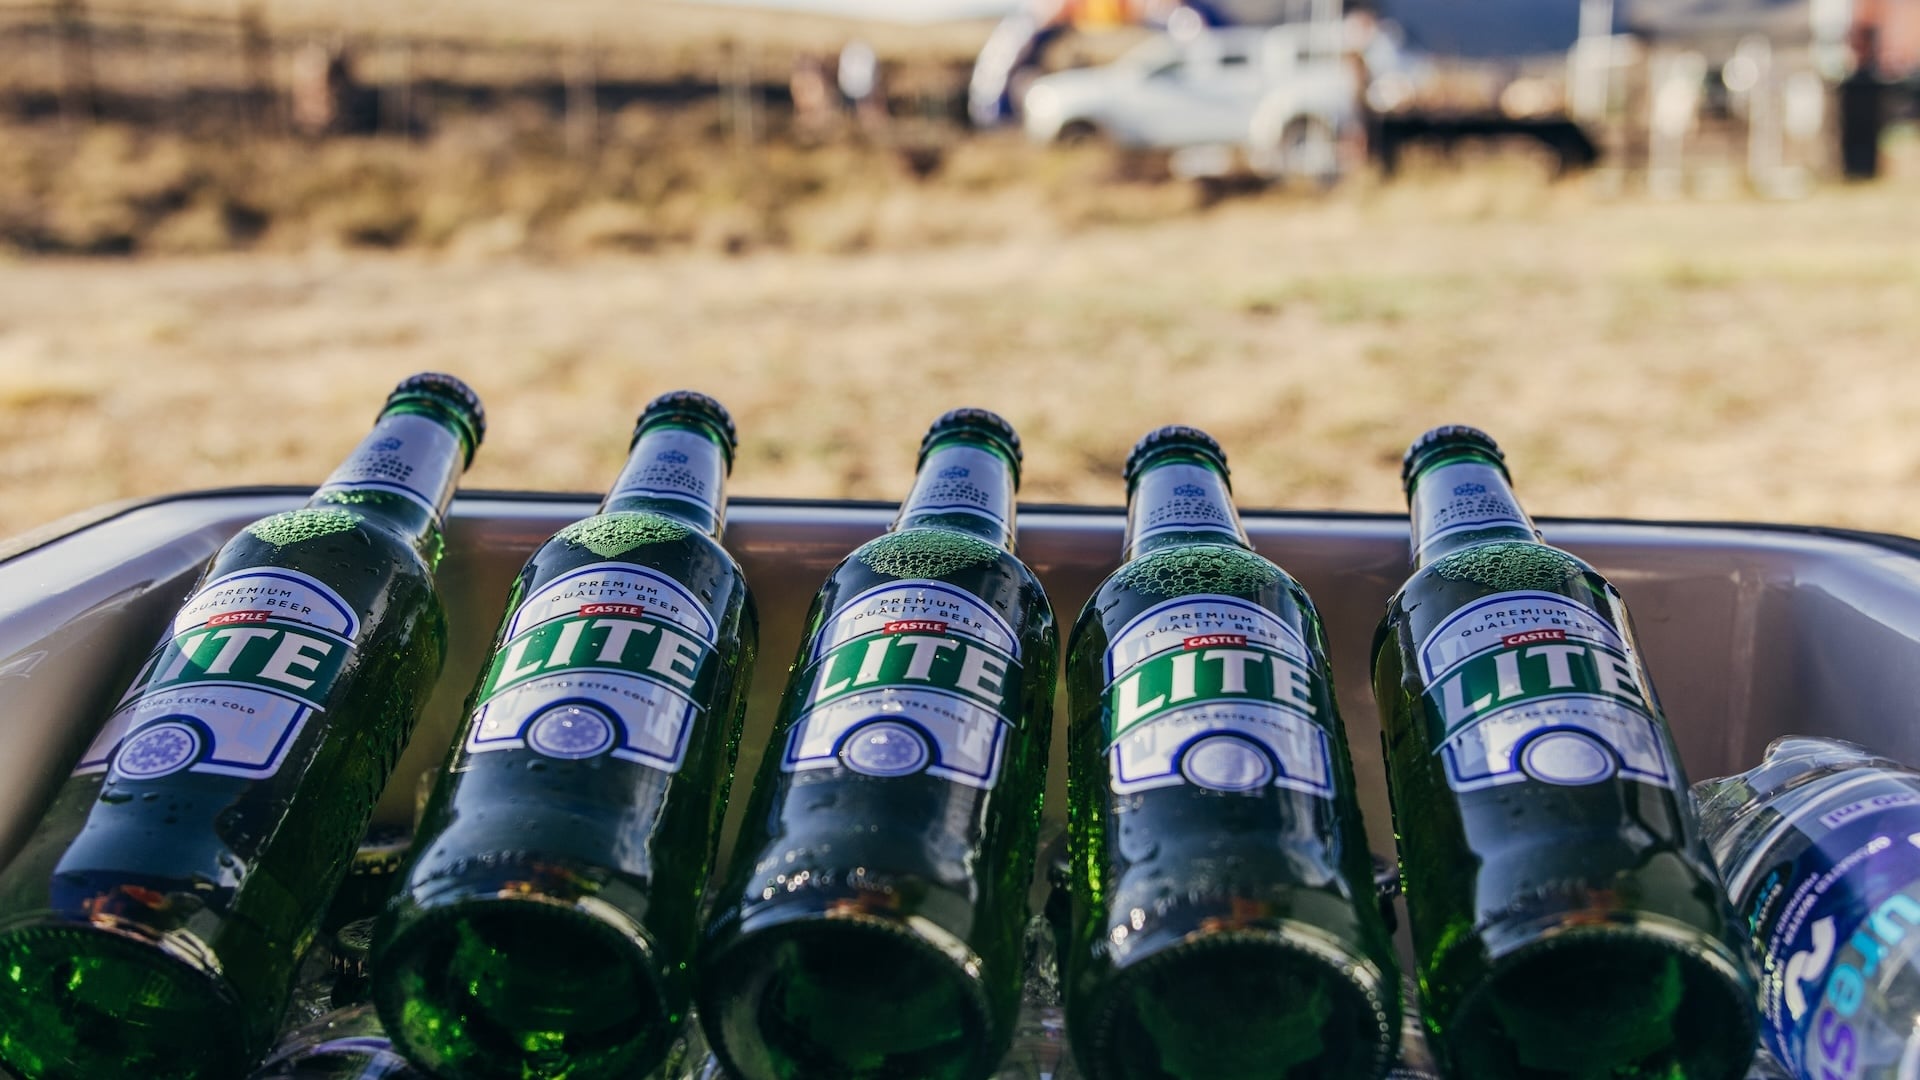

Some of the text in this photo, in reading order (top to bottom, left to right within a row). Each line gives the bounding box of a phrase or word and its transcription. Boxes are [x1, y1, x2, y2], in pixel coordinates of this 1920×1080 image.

[215, 587, 292, 599] PREMIUM
[578, 581, 658, 595] PREMIUM
[188, 597, 312, 615] QUALITY BEER
[551, 589, 681, 614] QUALITY BEER
[584, 604, 637, 615] CASTLE
[880, 598, 960, 611] PREMIUM
[211, 613, 264, 625] CASTLE
[853, 606, 983, 630] QUALITY BEER
[1169, 612, 1253, 623] PREMIUM
[1484, 609, 1567, 621] PREMIUM
[888, 622, 942, 632] CASTLE
[1145, 621, 1279, 640] QUALITY BEER
[1461, 617, 1596, 638] QUALITY BEER
[1188, 635, 1243, 647] CASTLE
[1507, 631, 1561, 645] CASTLE
[491, 618, 704, 692] LITE
[112, 627, 333, 713] LITE
[816, 634, 1009, 706] LITE
[578, 681, 618, 692] EXTRA
[623, 688, 656, 706] COLD
[1115, 650, 1318, 732] LITE
[1440, 645, 1643, 730] LITE
[178, 697, 216, 706] EXTRA
[222, 700, 256, 715] COLD
[1783, 893, 1818, 946] WATER
